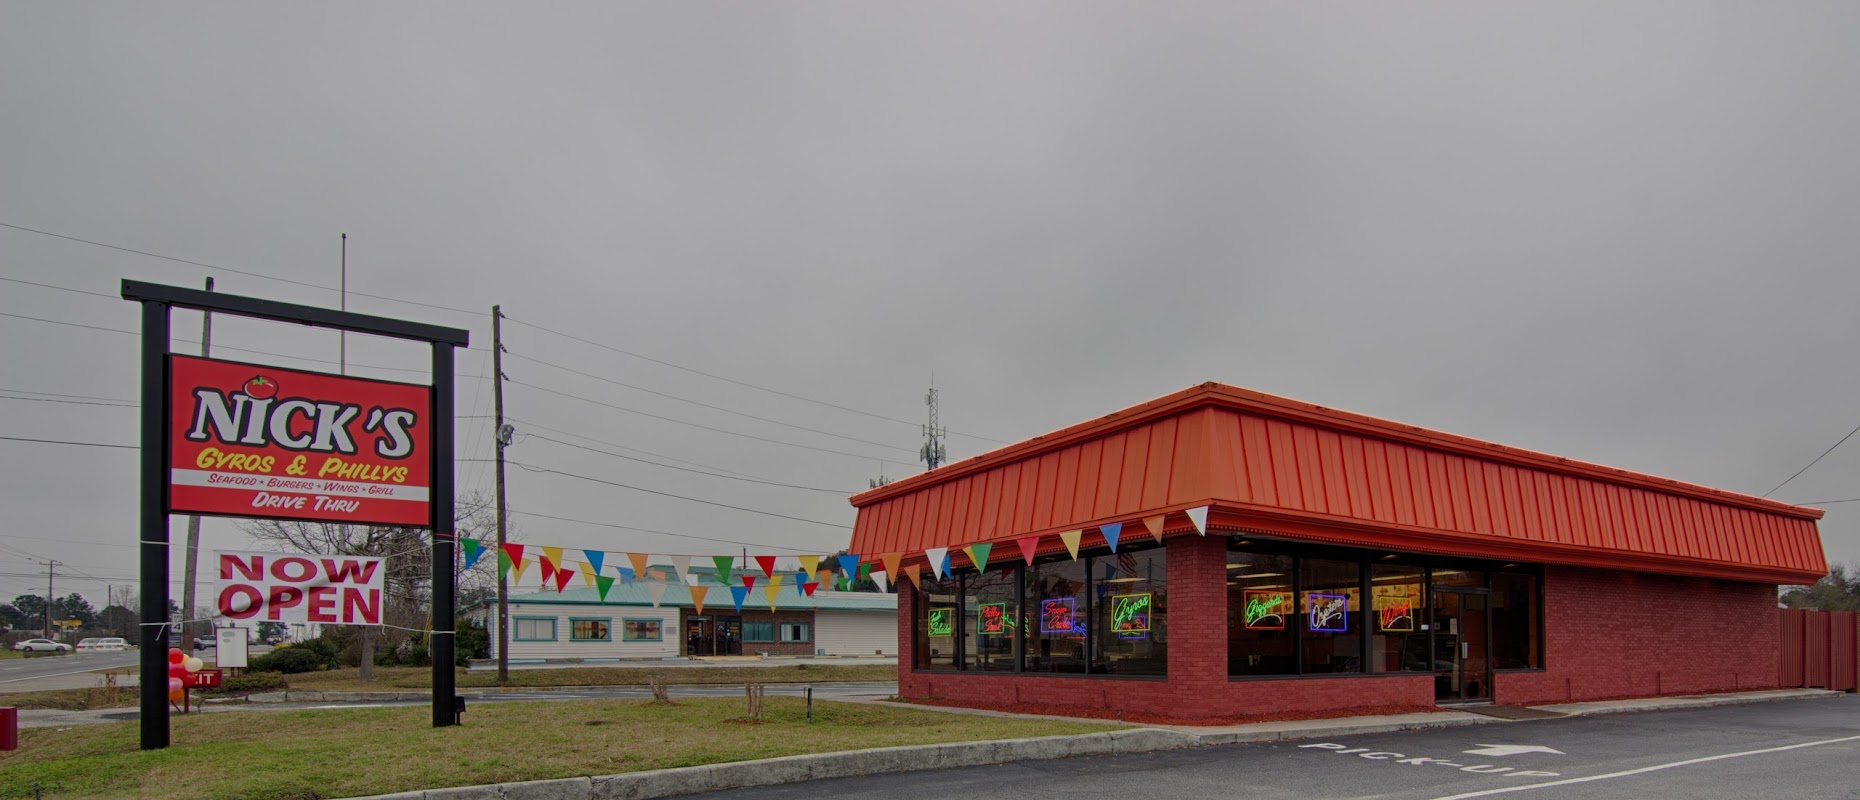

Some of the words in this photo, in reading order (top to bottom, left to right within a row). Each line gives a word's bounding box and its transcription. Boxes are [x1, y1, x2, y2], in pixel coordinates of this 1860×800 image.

[187, 387, 416, 459] NICK'S
[196, 447, 275, 473] GYROS
[285, 455, 308, 476] &
[318, 457, 409, 483] PHILLYS
[207, 473, 257, 486] SEAFOOD
[266, 478, 314, 491] BURGERS
[323, 482, 360, 494] WINGS
[368, 485, 394, 496] GRILL
[251, 492, 308, 510] DRIVE
[313, 496, 360, 513] THRU
[220, 554, 379, 585] NOW
[218, 583, 380, 624] OPEN
[1113, 596, 1149, 630] Gyros
[1297, 742, 1561, 777] PICK-UP
